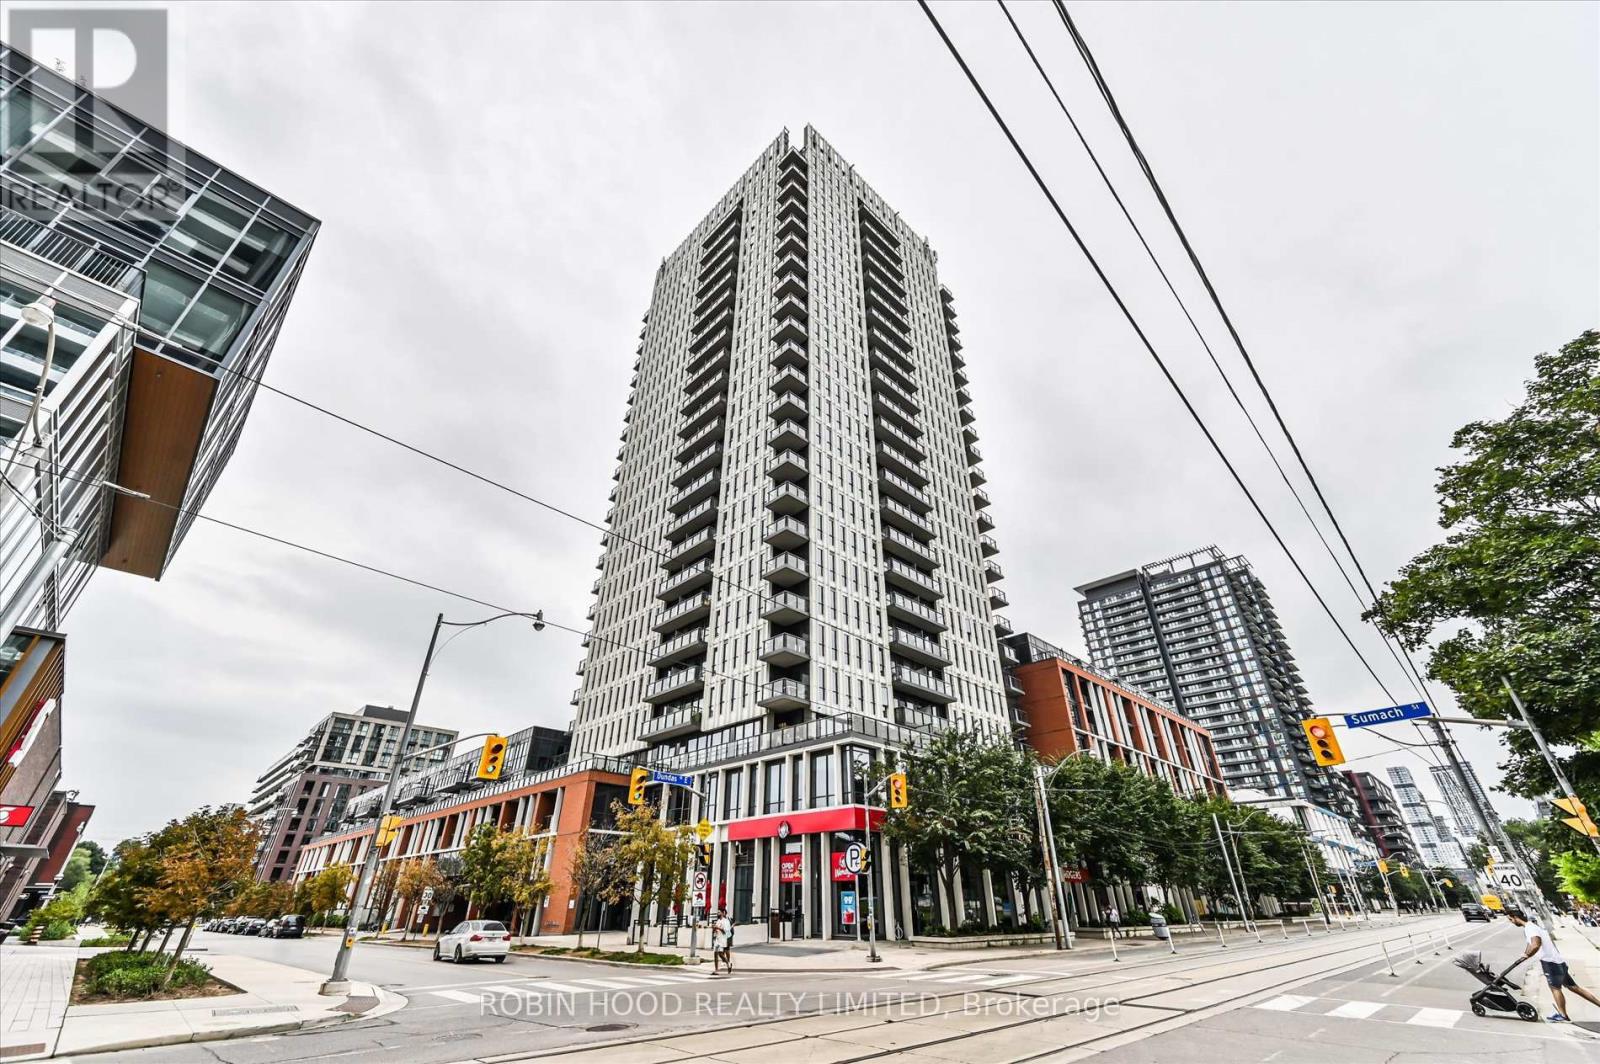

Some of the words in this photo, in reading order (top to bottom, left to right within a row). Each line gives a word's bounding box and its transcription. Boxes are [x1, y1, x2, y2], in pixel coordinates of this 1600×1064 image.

[1351, 708, 1404, 725] Sumach
[656, 772, 678, 782] Dundas
[1501, 875, 1522, 887] 40
